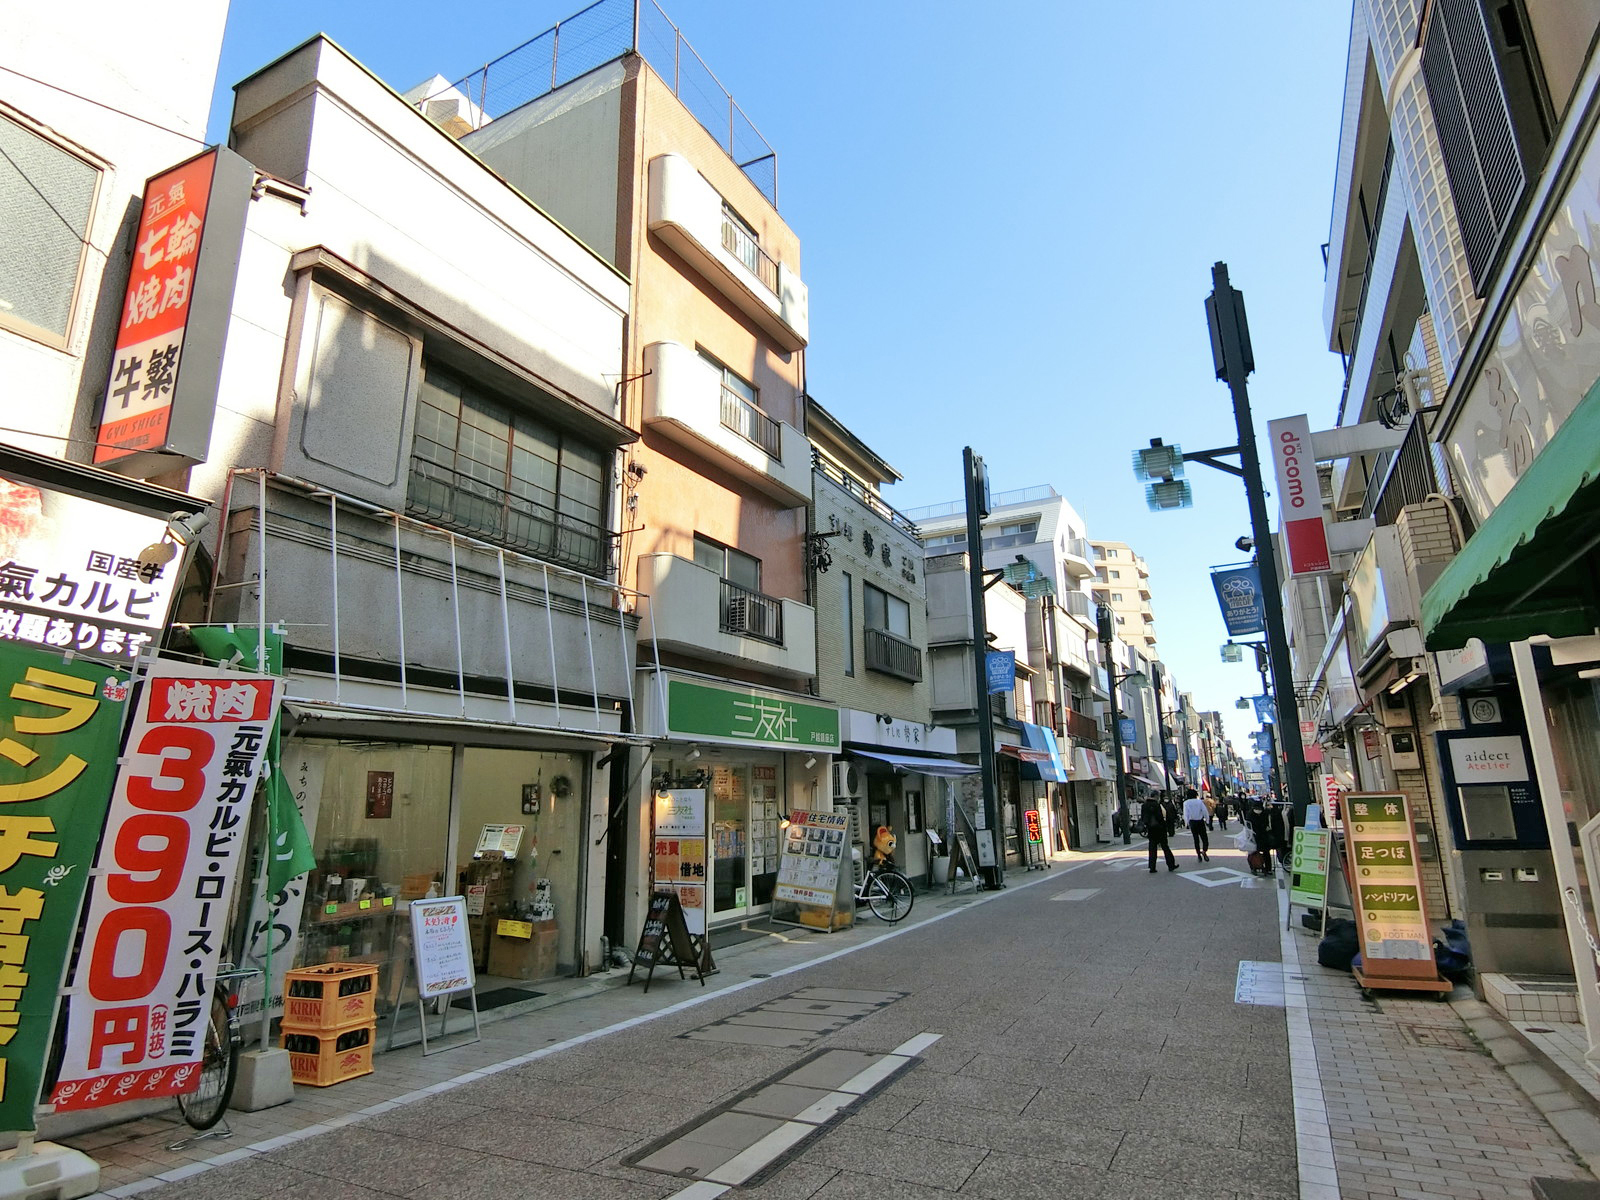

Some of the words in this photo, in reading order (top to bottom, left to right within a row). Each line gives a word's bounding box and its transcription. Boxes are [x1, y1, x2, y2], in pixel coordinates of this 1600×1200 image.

[148, 180, 186, 218] 元氣
[139, 211, 201, 271] 七輪
[126, 265, 192, 329] 焼肉
[112, 344, 179, 410] 牛繁
[106, 423, 128, 440] GYU
[131, 413, 163, 433] SHIGE
[1281, 431, 1305, 508] docomo
[86, 550, 164, 585] 国産牛
[164, 680, 259, 720] 焼肉
[731, 699, 799, 742] 三友社
[1465, 750, 1511, 761] aidect
[1467, 762, 1511, 771] Atelier
[656, 841, 679, 856] 売買
[681, 862, 705, 877] 借地
[87, 726, 216, 1071] 390円
[680, 887, 695, 897] 住宅
[681, 899, 702, 907] ローン
[1365, 892, 1415, 903] ハンドリフレ
[1384, 931, 1405, 939] FOOT
[290, 1001, 321, 1016] KIRIN
